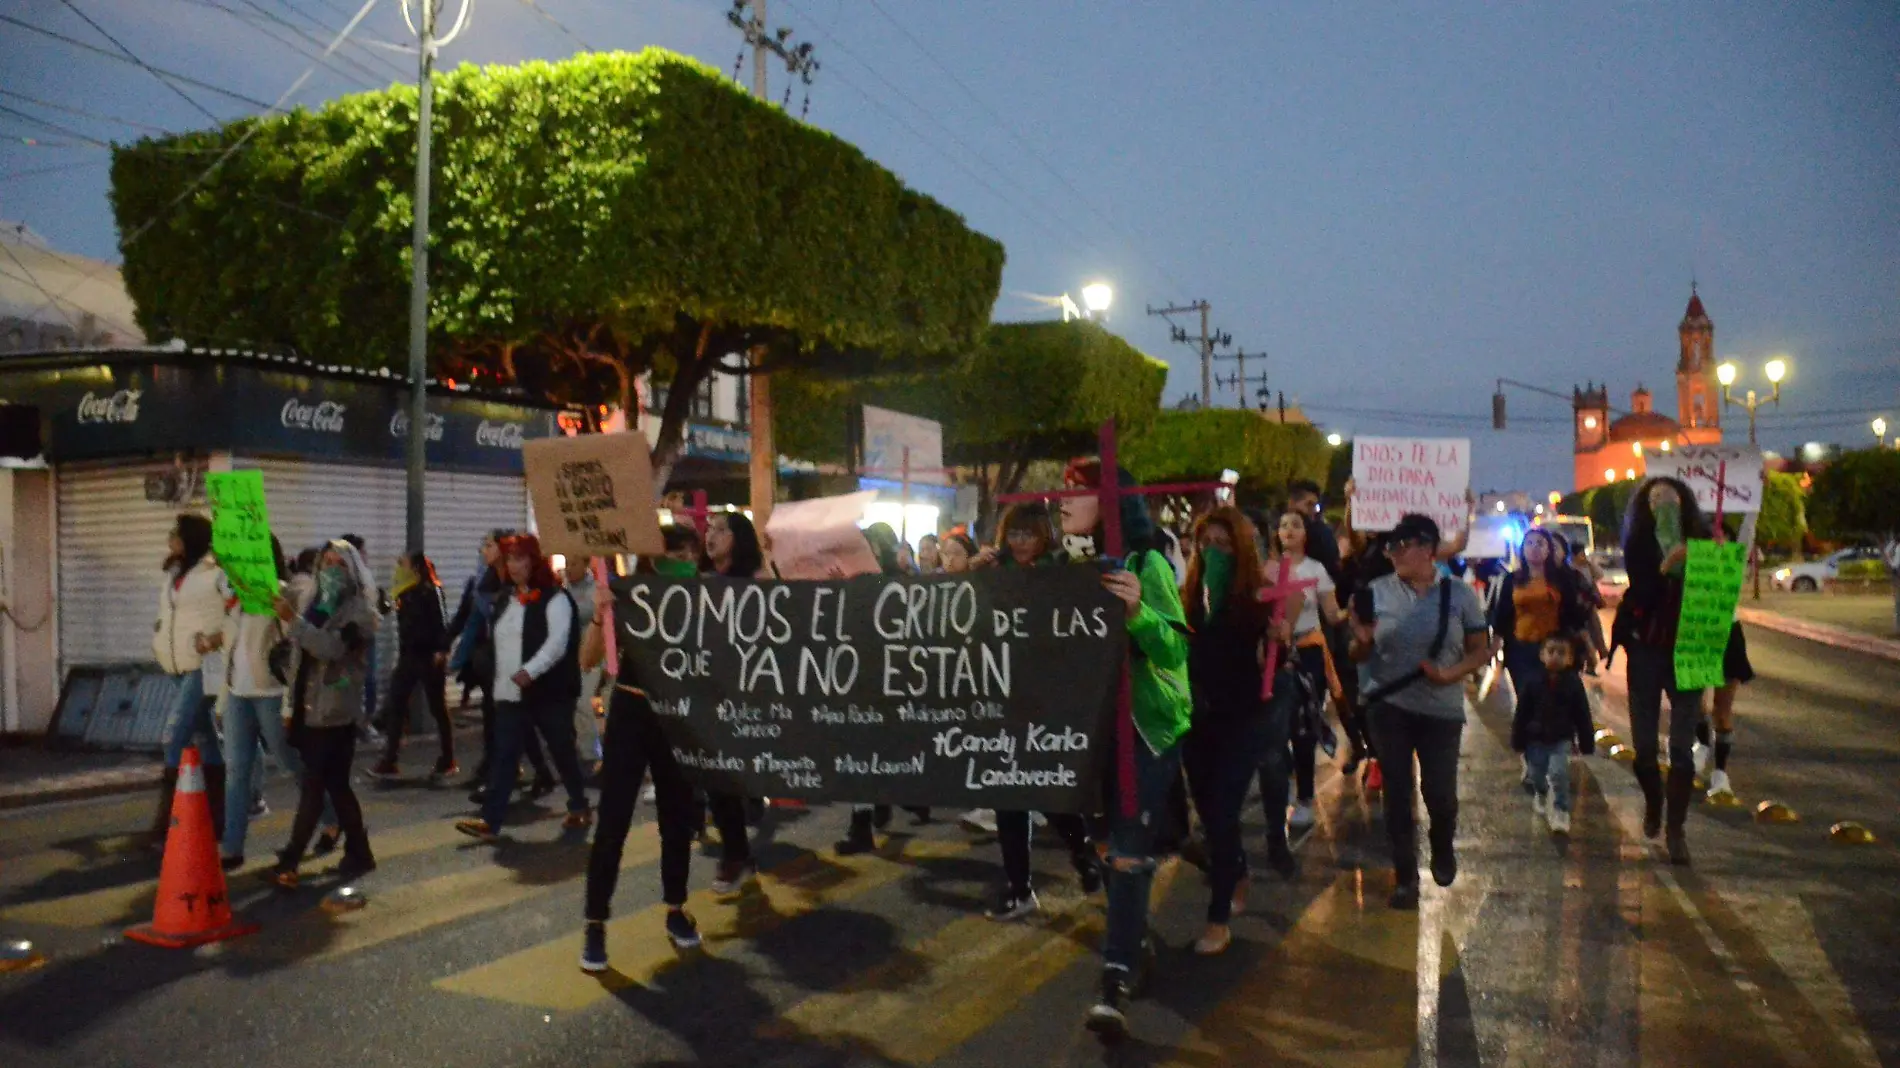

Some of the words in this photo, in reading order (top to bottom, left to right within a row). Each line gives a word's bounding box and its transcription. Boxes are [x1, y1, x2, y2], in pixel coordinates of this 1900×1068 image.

[1360, 443, 1403, 462] DIOS
[1436, 445, 1457, 465] LA
[624, 583, 792, 648] SOMOS
[811, 587, 852, 641] EL
[873, 581, 977, 641] GRITO
[992, 607, 1030, 638] DE
[1052, 606, 1109, 639] LAS
[660, 647, 713, 681] QUE
[735, 643, 785, 696] YA
[797, 643, 860, 696] NO
[1026, 721, 1089, 752] Karla
